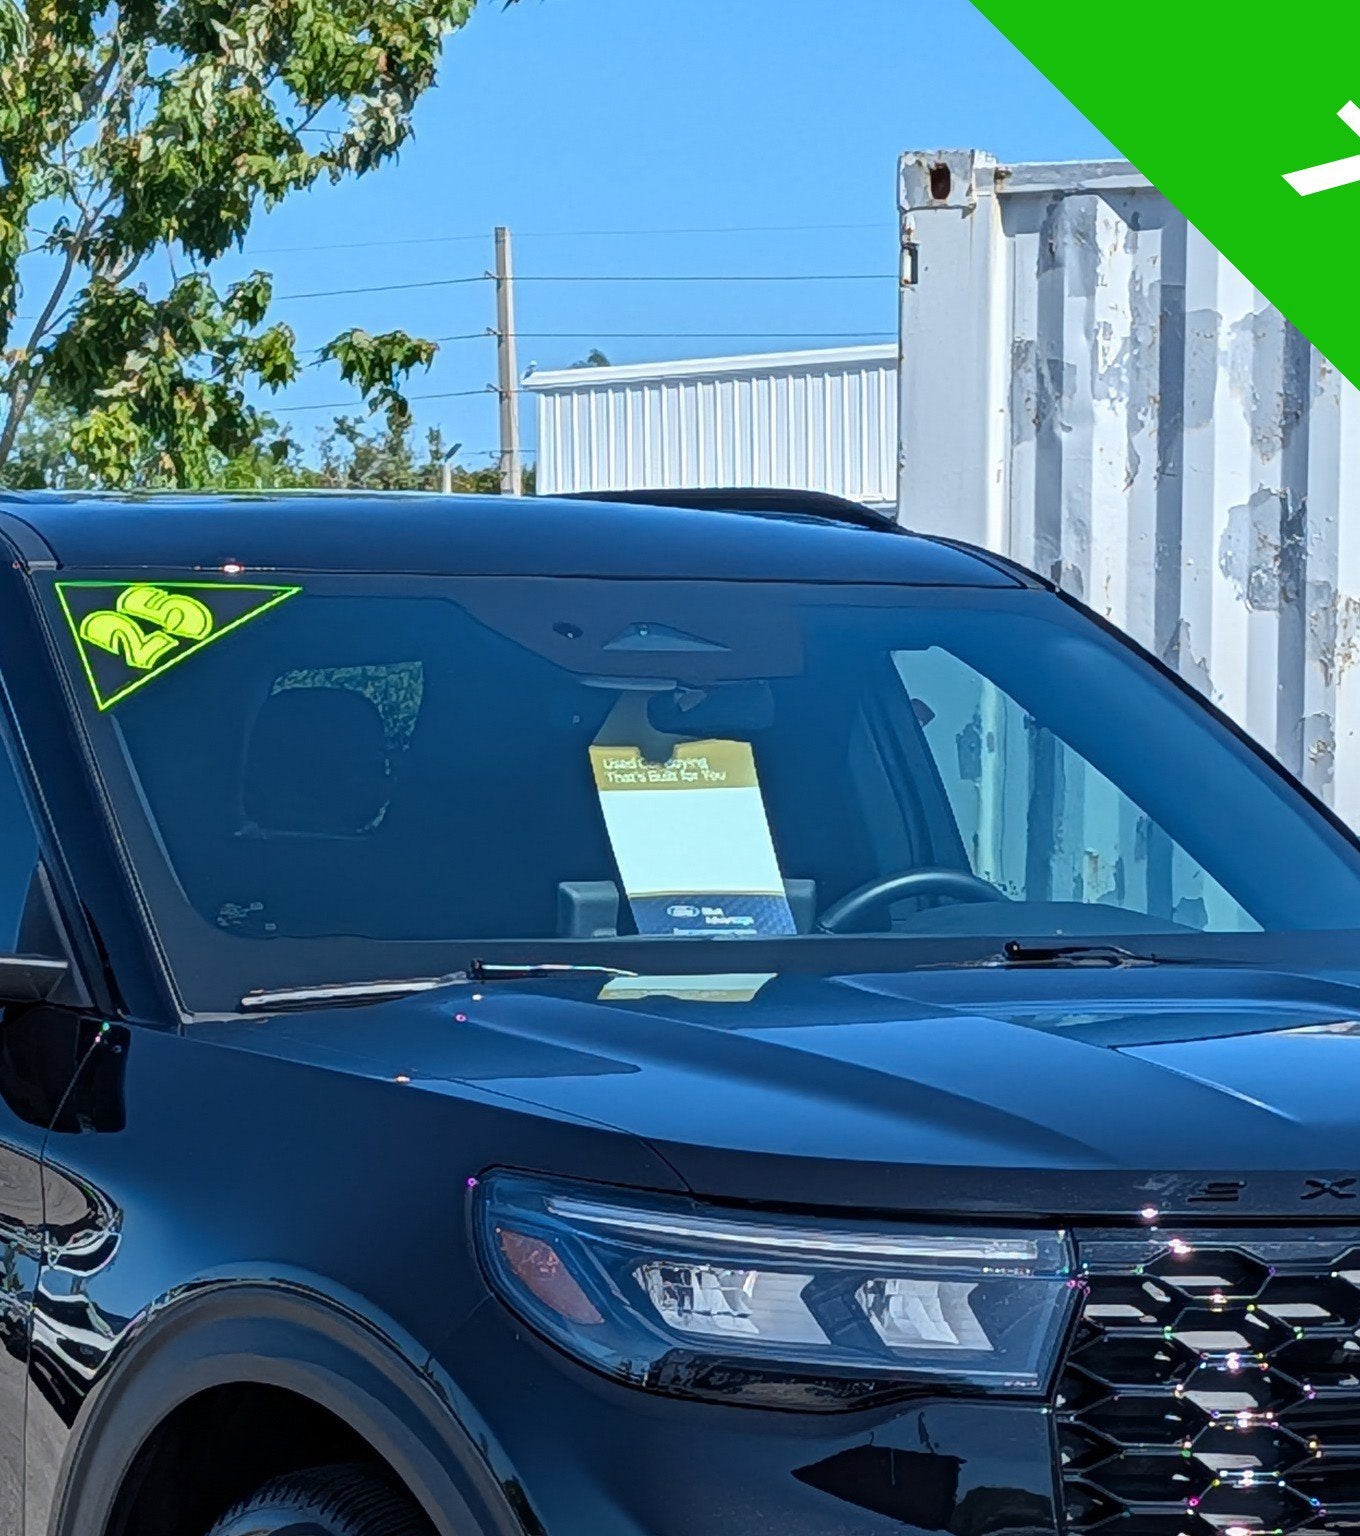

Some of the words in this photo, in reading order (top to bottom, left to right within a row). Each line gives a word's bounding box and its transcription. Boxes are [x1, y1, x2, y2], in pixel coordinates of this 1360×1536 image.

[80, 585, 213, 670] 25
[603, 757, 637, 770] Used
[701, 770, 727, 781] You
